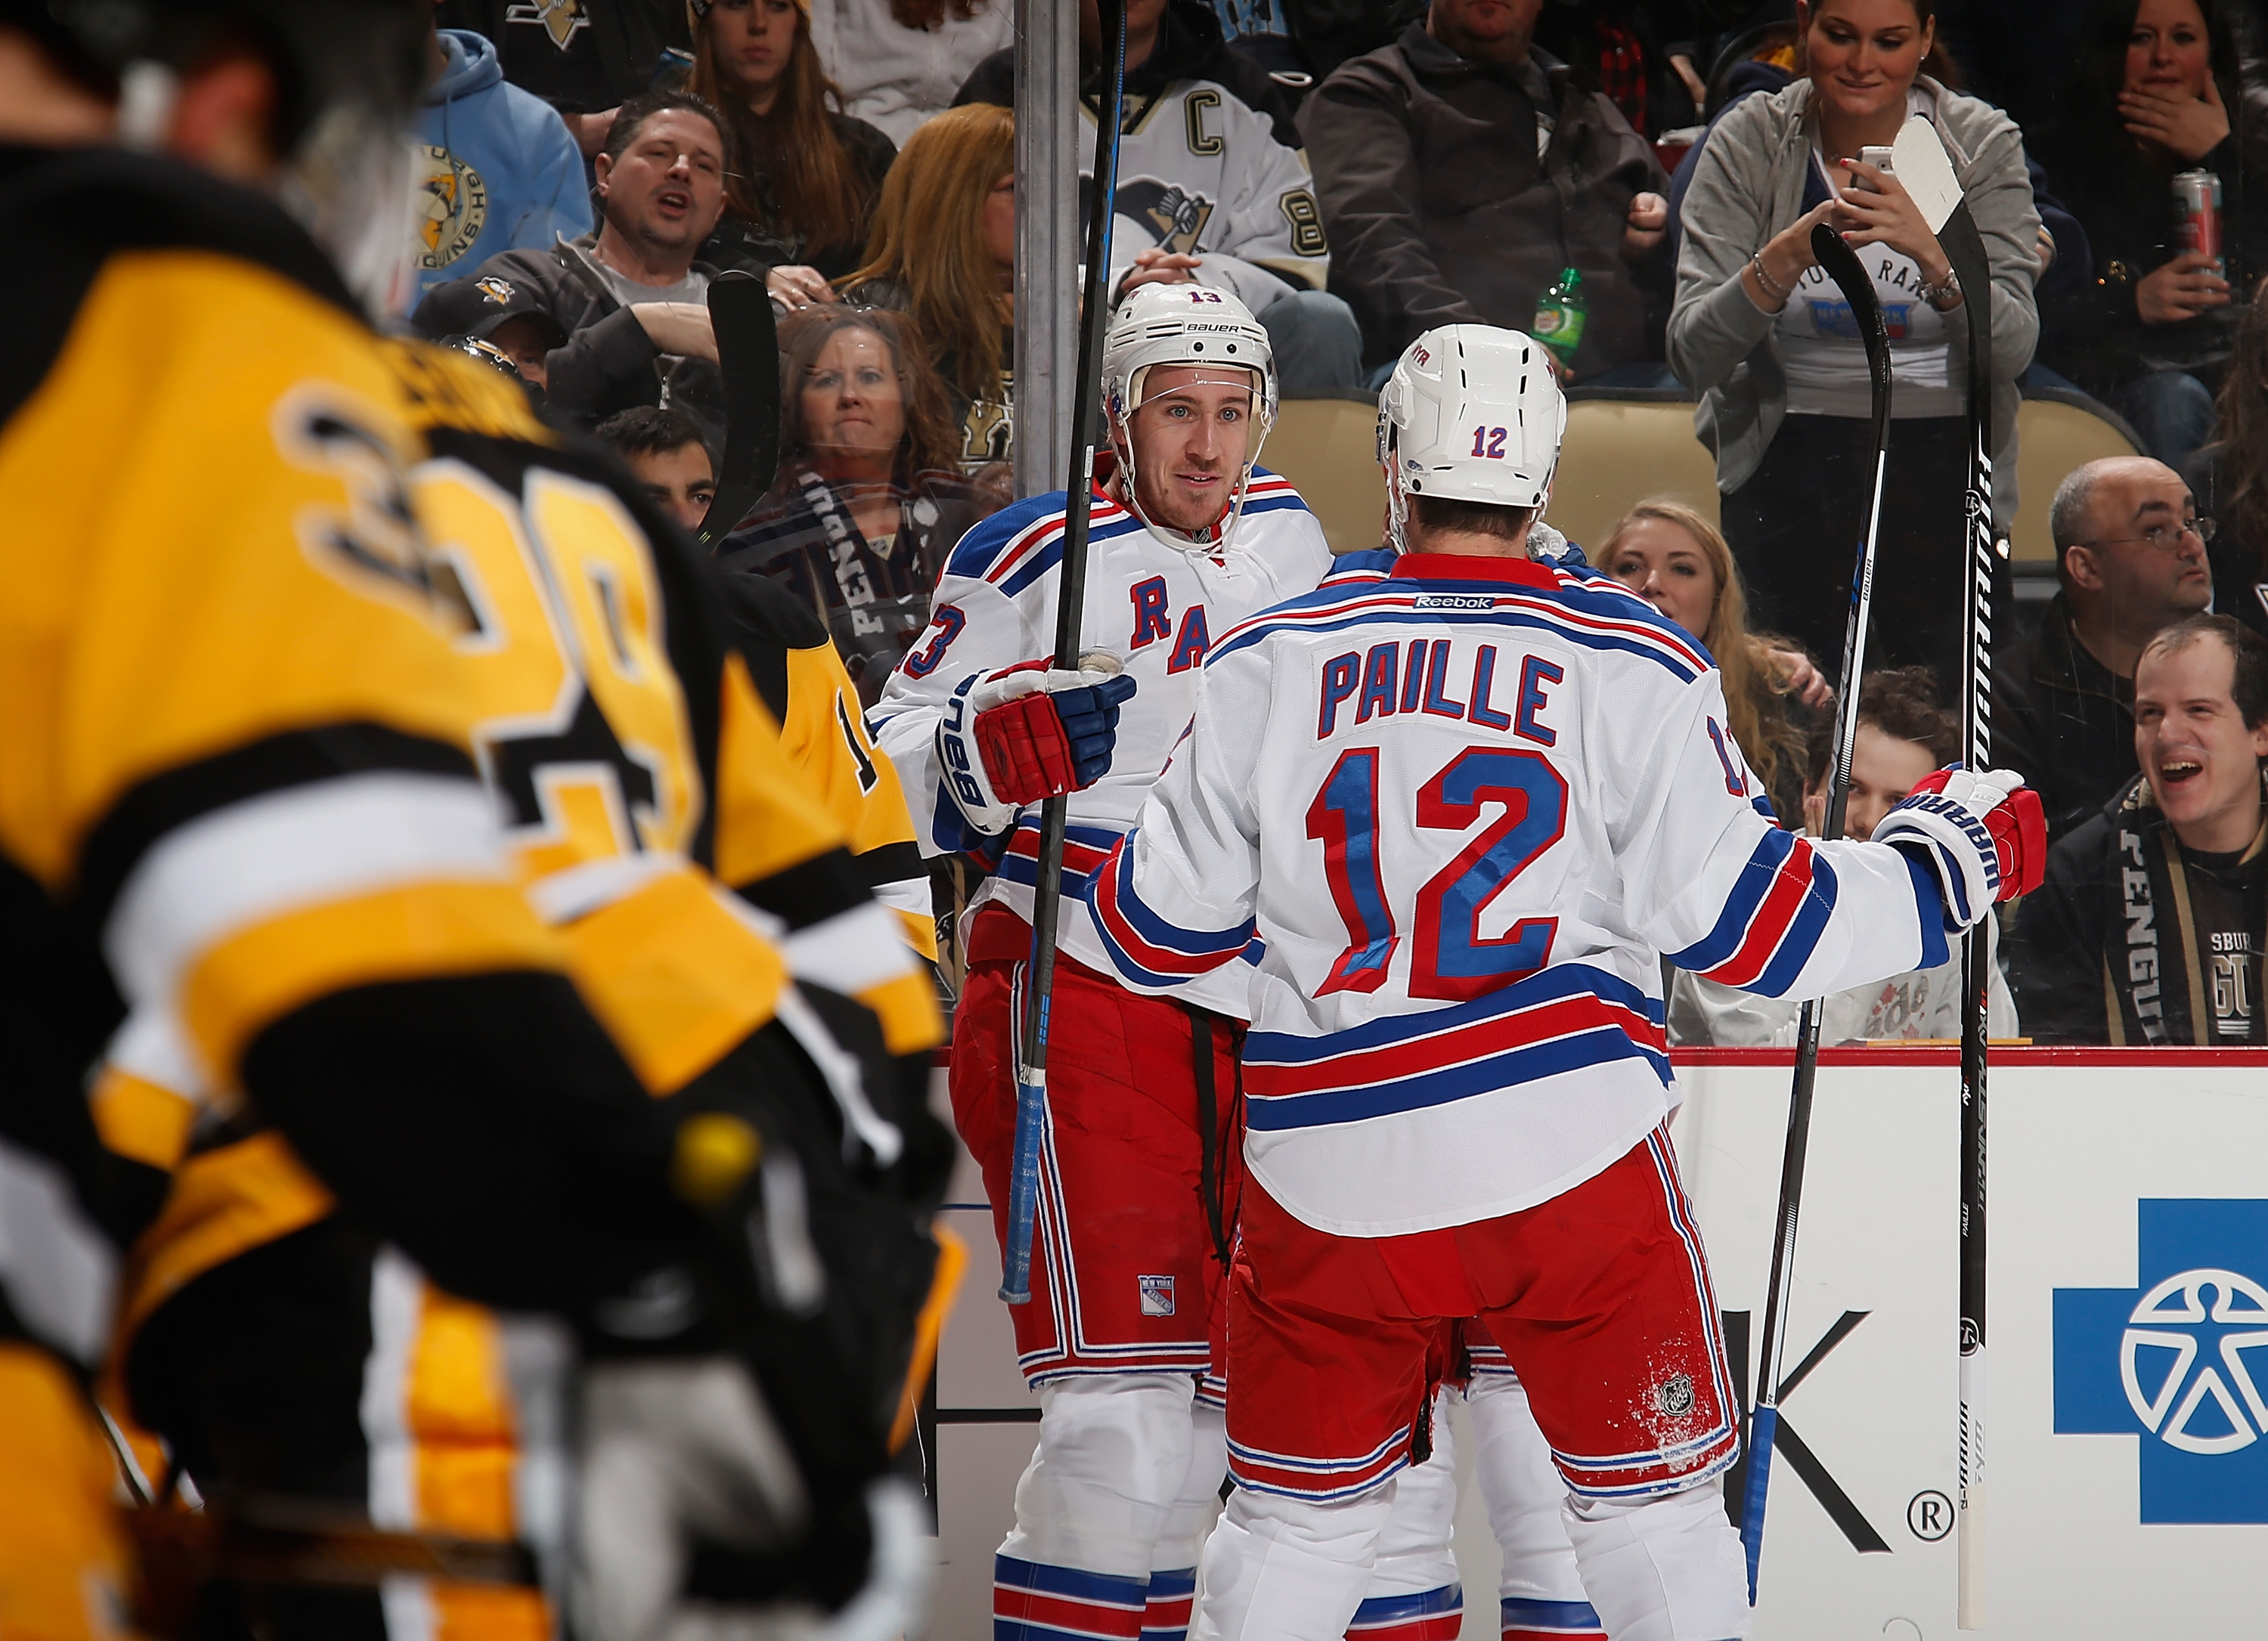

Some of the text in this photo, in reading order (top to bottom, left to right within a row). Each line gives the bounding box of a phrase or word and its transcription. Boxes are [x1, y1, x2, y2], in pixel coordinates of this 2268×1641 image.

[1184, 89, 1223, 156] C
[1278, 188, 1328, 257] 8
[1186, 324, 1239, 333] BAUER
[1188, 290, 1222, 304] 13
[1470, 426, 1508, 460] 12
[1416, 596, 1492, 608] Reebok
[1863, 558, 1873, 602] BAUER
[894, 602, 968, 680] 3
[1130, 574, 1211, 675] RA
[1317, 639, 1564, 747] PAILLE
[835, 684, 879, 798] 1
[1706, 714, 1750, 797] 1
[1306, 746, 1569, 1002] 12
[1142, 1279, 1172, 1289] NEW YORK
[1147, 1289, 1172, 1312] RANGERS
[1960, 1400, 1969, 1489] RRIOR
